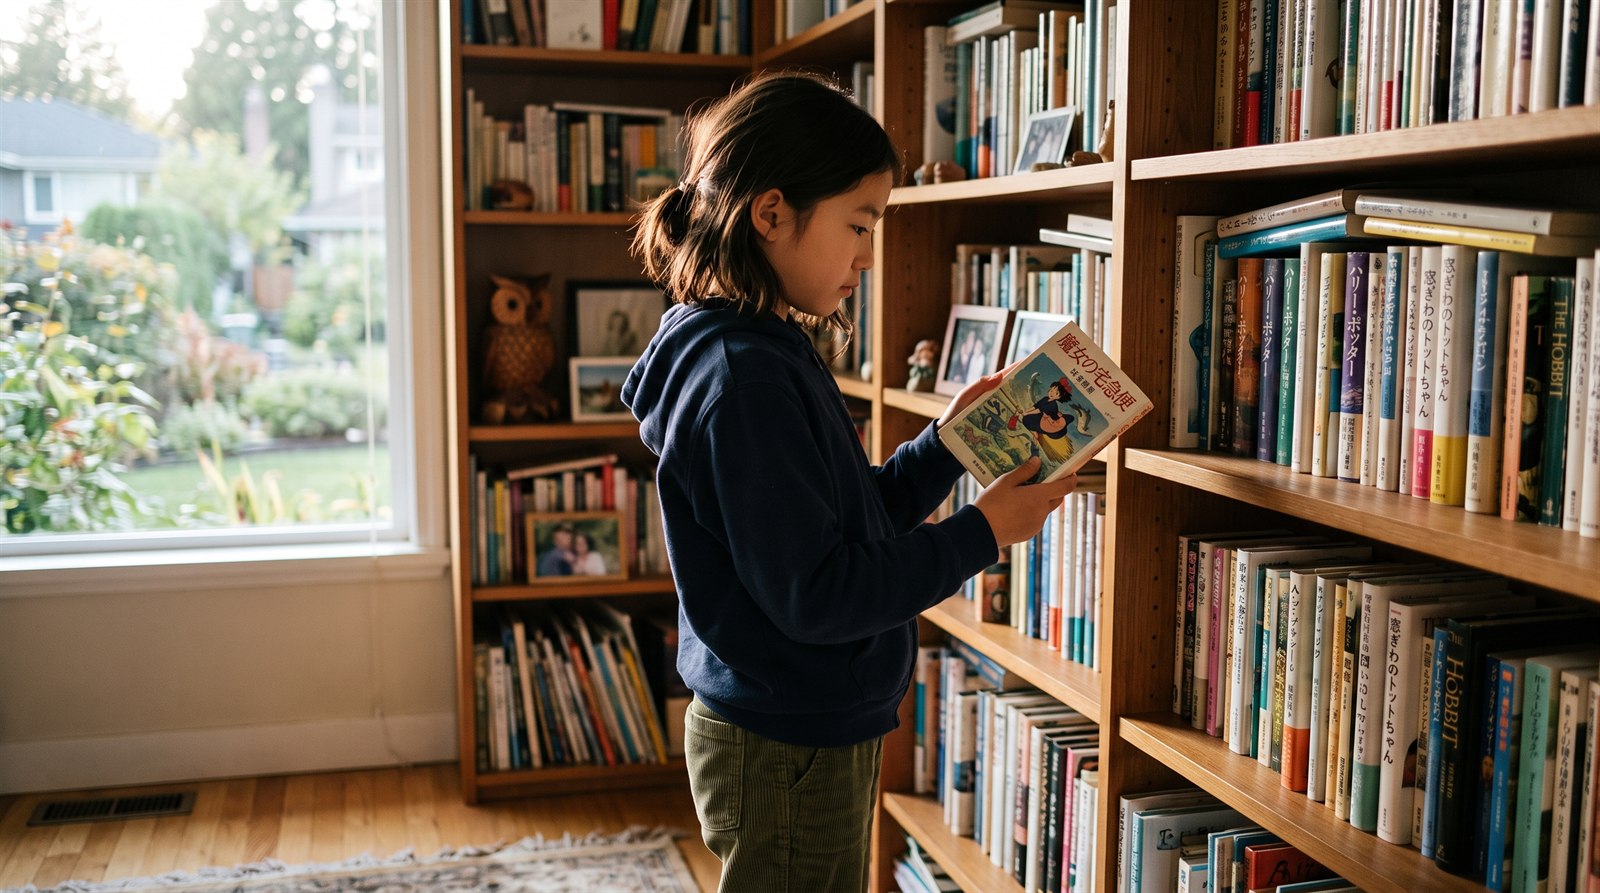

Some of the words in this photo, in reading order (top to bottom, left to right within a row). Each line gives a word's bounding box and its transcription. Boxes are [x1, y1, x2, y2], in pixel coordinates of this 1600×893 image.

[1262, 275, 1275, 377] ハリー・ポッター
[1346, 266, 1363, 377] ハリー・ポッター
[1554, 295, 1569, 329] THE
[1056, 333, 1137, 412] 魔女の宅急便
[1549, 332, 1567, 399] HOBBIT
[1383, 617, 1401, 764] 窓ぎわのトットちゃん
